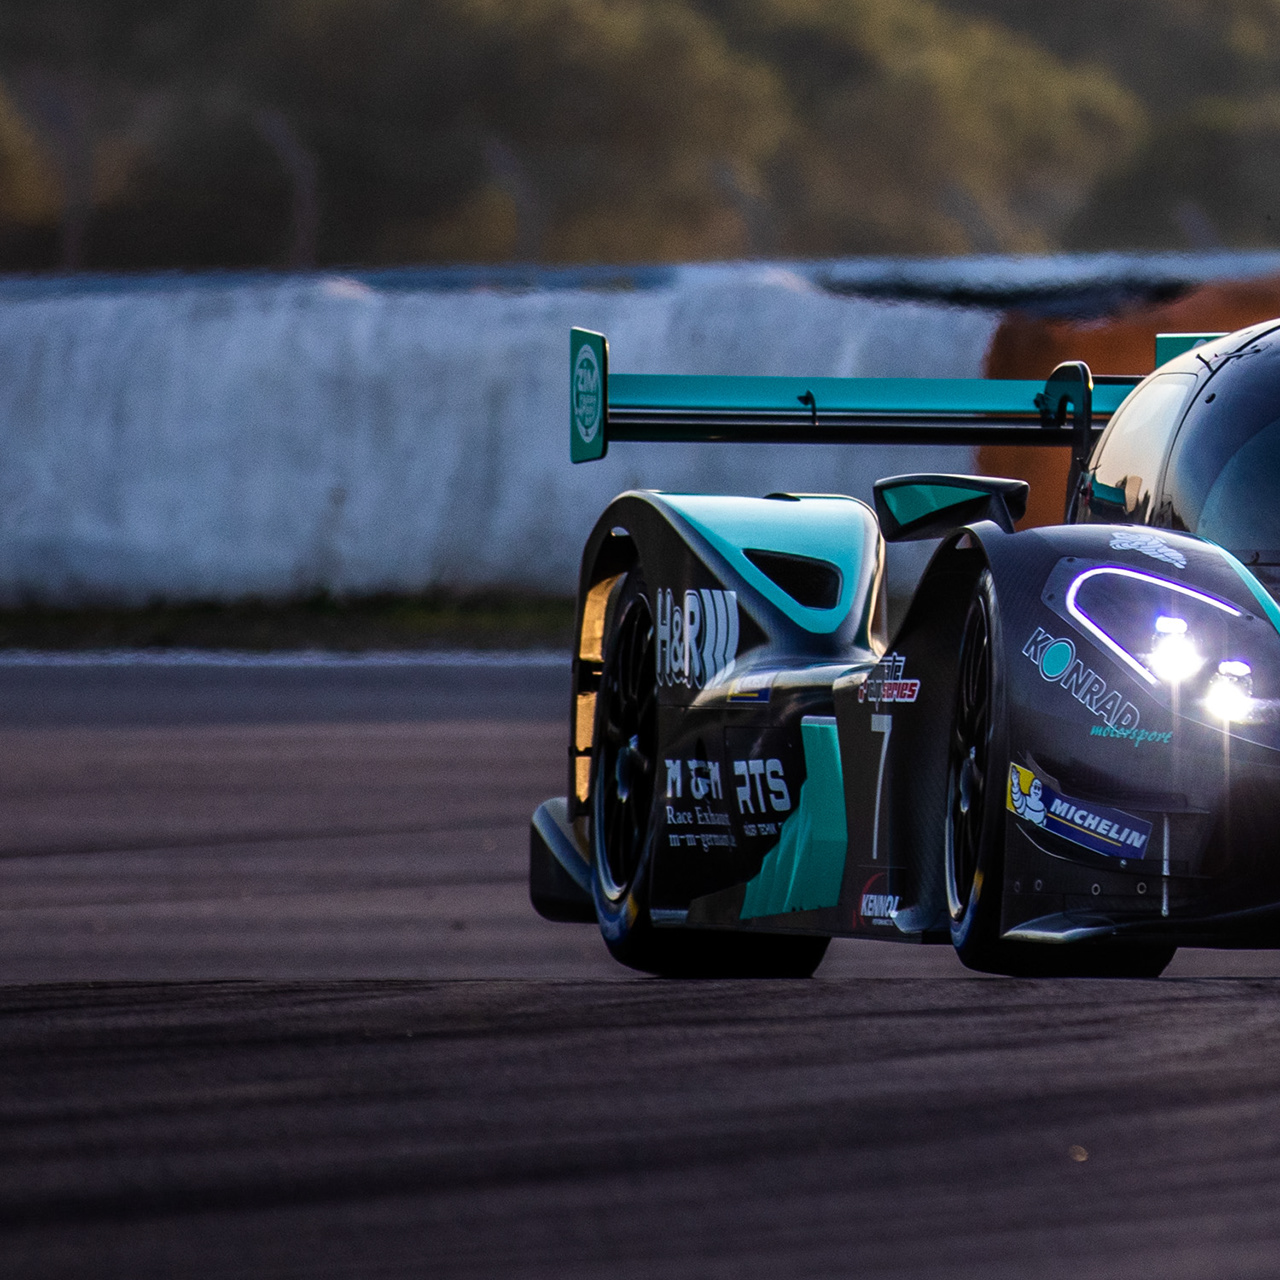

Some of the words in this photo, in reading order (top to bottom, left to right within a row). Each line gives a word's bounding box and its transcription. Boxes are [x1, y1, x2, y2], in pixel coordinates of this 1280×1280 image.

[656, 588, 704, 689] H&R
[1022, 627, 1140, 735] KONRAD
[1090, 724, 1173, 747] motorsport
[664, 759, 682, 798] M
[733, 758, 792, 814] RTS
[871, 714, 892, 859] 7
[666, 806, 693, 824] Race
[1050, 798, 1147, 848] MICHELIN
